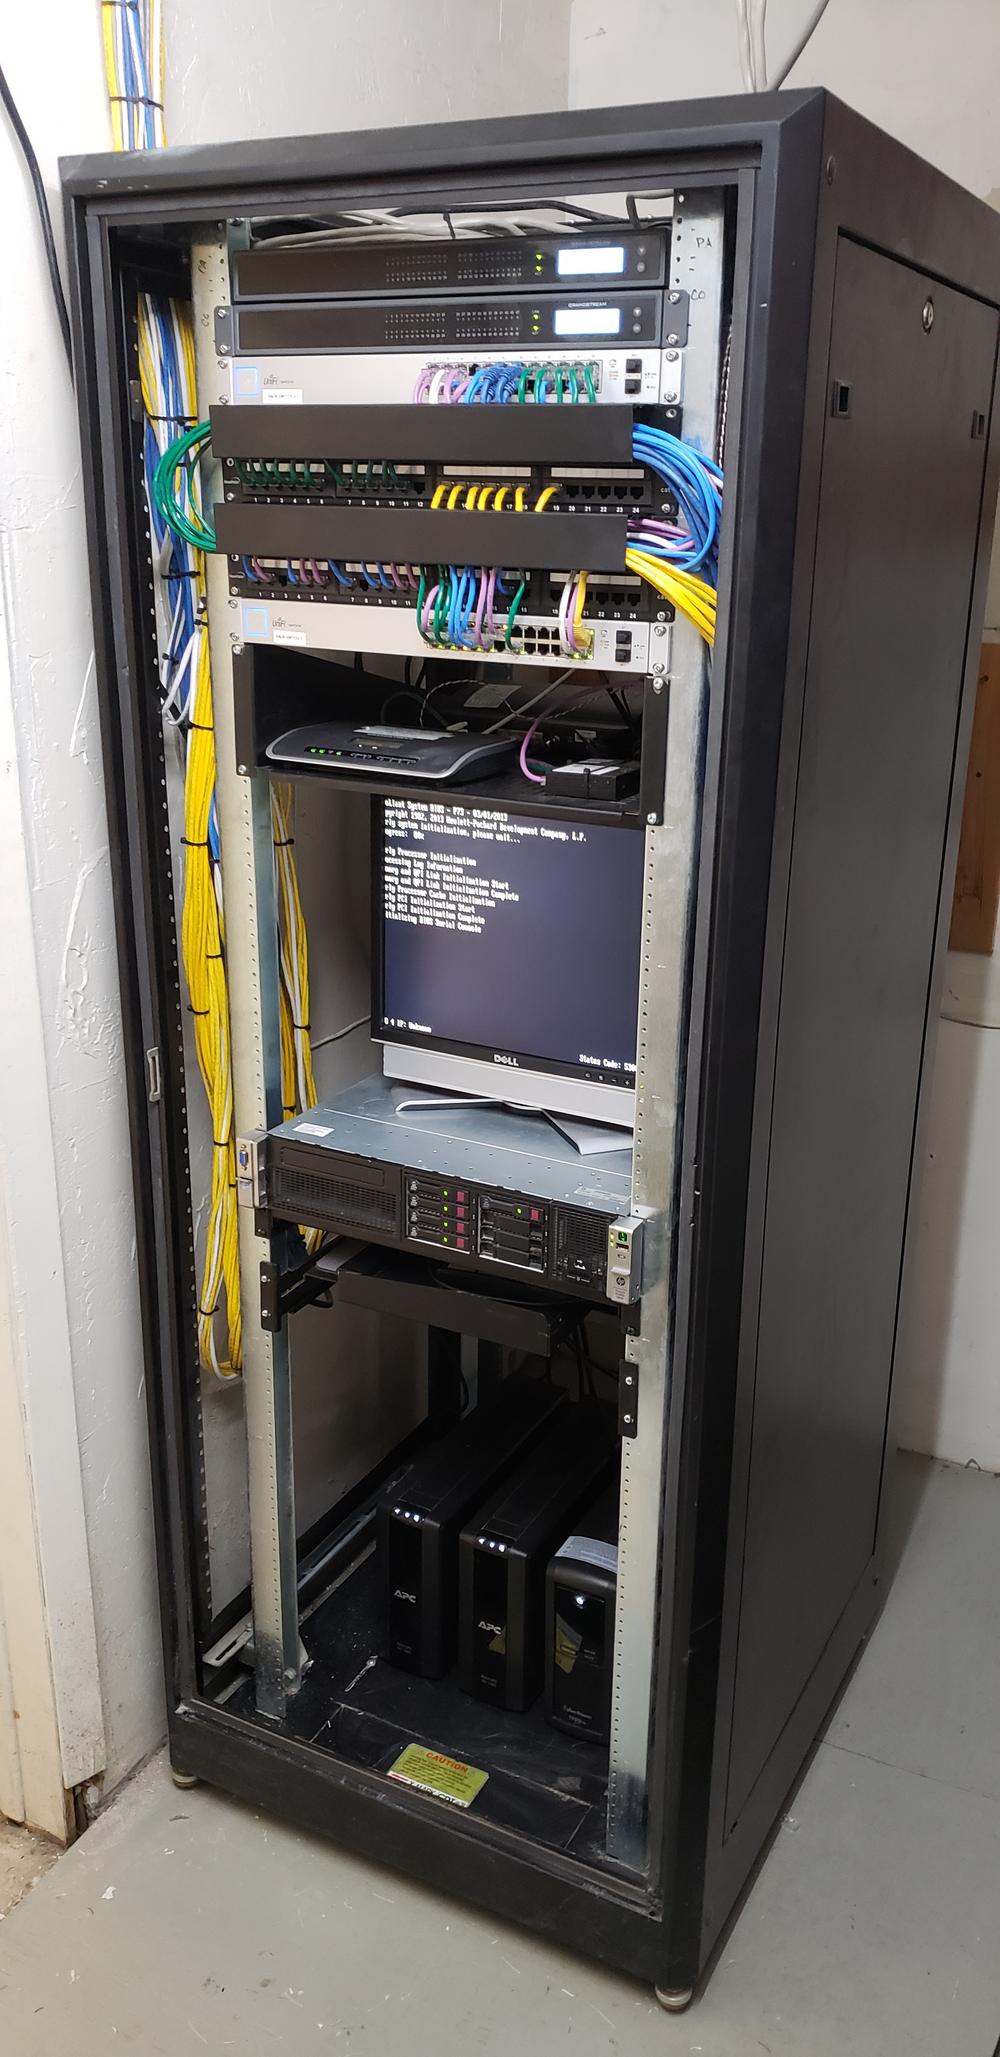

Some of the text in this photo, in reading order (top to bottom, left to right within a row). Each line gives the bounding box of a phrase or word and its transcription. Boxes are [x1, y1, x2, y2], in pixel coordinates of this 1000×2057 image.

[696, 237, 712, 249] PA
[430, 803, 445, 814] BIOS
[446, 816, 498, 831] Hewlett-Packard
[500, 822, 539, 836] Development
[540, 826, 570, 842] Company,
[572, 831, 587, 842] L.P.
[472, 830, 494, 840] please
[496, 832, 520, 844] wait...
[426, 860, 464, 874] Information
[430, 852, 477, 867] Initialization
[426, 870, 440, 880] Link
[442, 872, 490, 888] Initialization
[491, 879, 510, 890] Start
[426, 879, 440, 890] Link
[442, 882, 490, 897] Initialization
[490, 888, 520, 902] Complete
[397, 894, 408, 904] PCI
[410, 895, 457, 911] Initialization
[458, 902, 476, 914] Start
[448, 892, 496, 908] Initialization
[397, 902, 408, 912] PCI
[410, 904, 457, 920] Initialization
[458, 912, 486, 925] Complete
[434, 918, 456, 930] Serial
[457, 922, 482, 934] Console
[494, 1054, 520, 1066] DELL
[579, 1054, 601, 1066] Status
[602, 1058, 622, 1069] Code:
[394, 1589, 416, 1604] APC
[478, 1620, 502, 1634] APC
[426, 1752, 469, 1774] CAUTION
